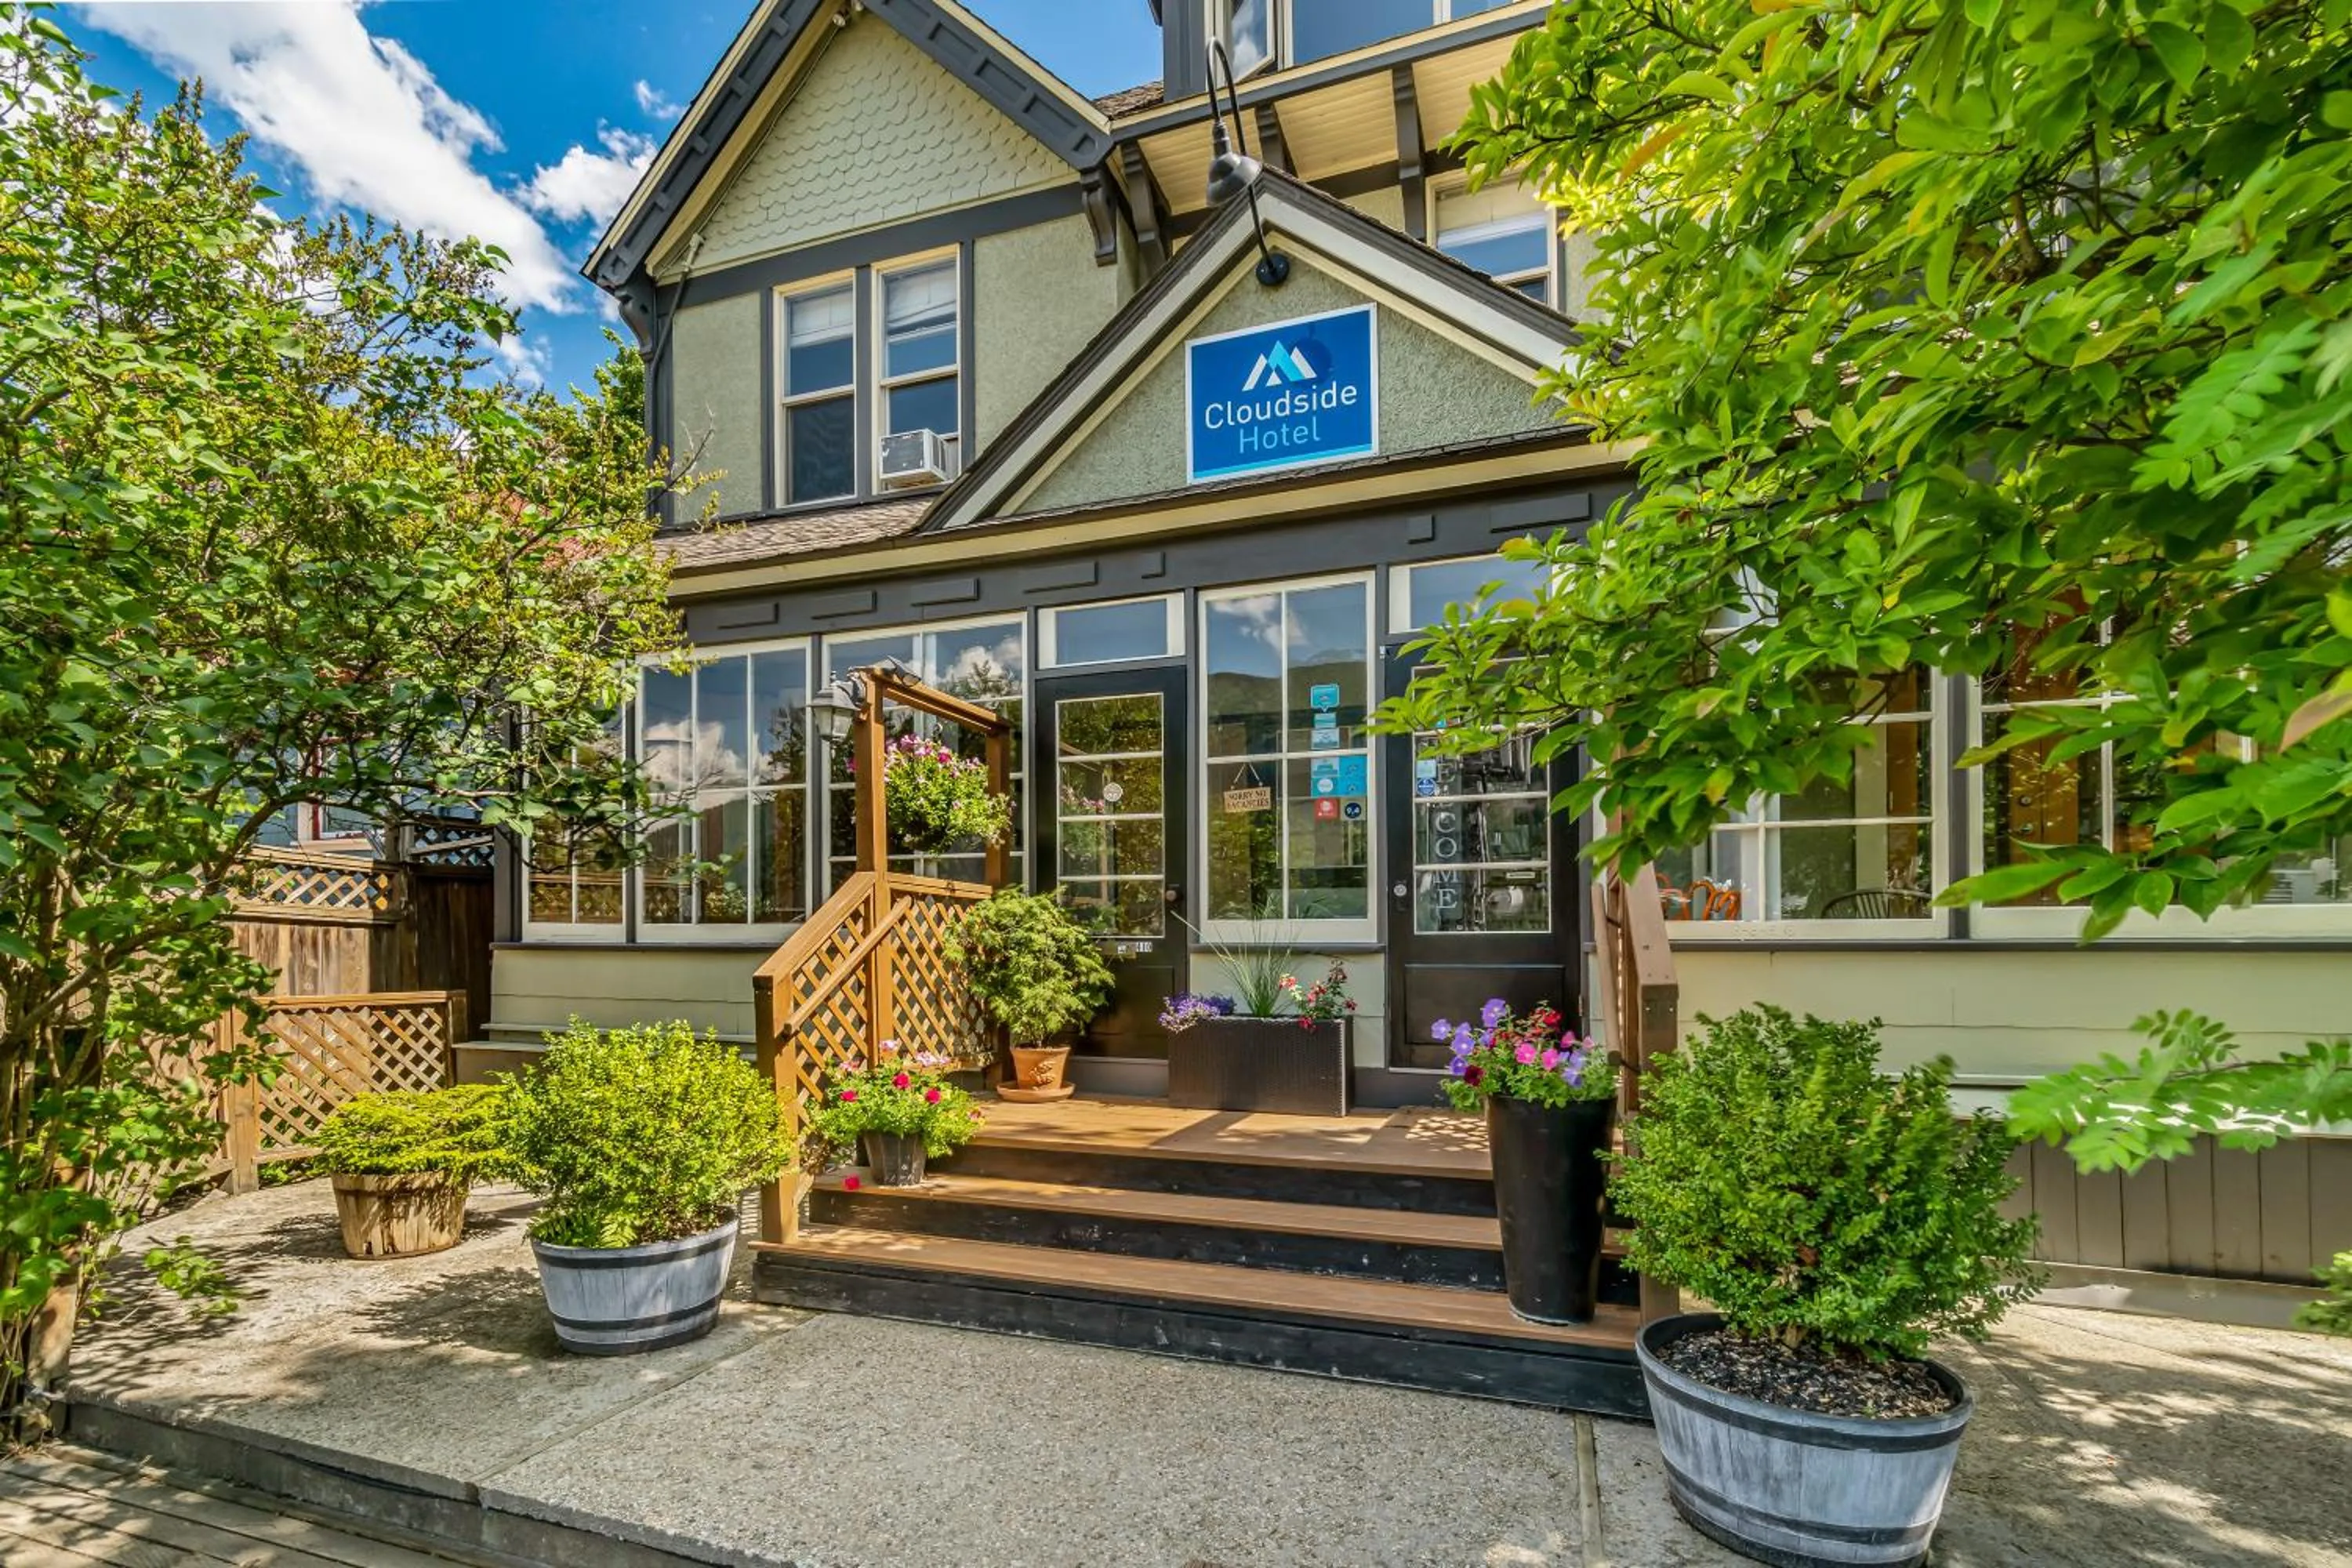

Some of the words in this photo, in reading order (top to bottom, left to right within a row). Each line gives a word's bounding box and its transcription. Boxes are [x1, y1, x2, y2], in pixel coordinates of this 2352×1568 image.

[1205, 380, 1357, 429] Cloudside
[1239, 416, 1321, 454] Hotel
[1229, 790, 1254, 800] SORRY
[1227, 797, 1269, 810] VACANCIES
[1136, 941, 1152, 952] 410
